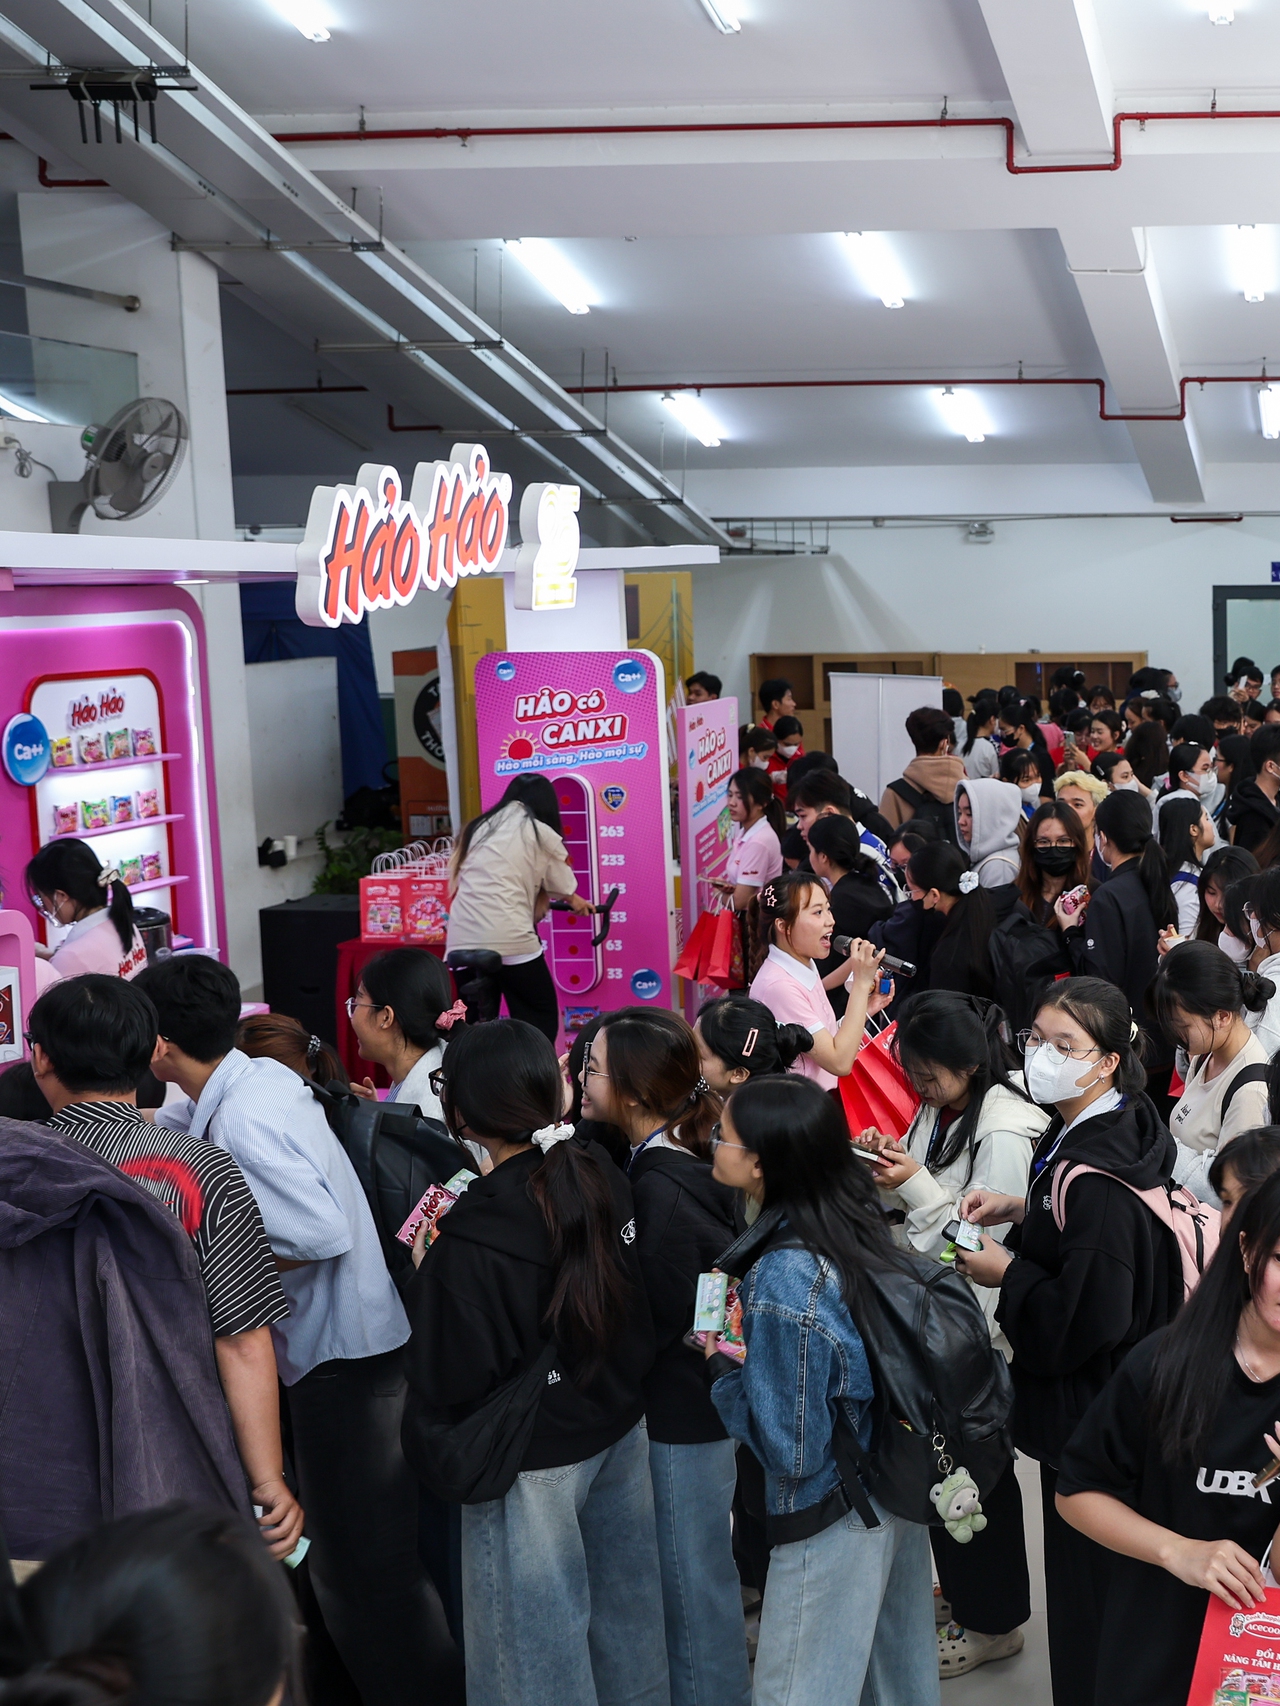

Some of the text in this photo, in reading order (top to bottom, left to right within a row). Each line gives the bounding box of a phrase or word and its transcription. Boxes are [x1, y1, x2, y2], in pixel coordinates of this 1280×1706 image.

[323, 454, 505, 620] Hảo Hảo
[618, 672, 642, 683] Ca++
[72, 688, 125, 727] Hảo Hảo
[516, 689, 601, 718] HẢO có
[543, 716, 622, 745] CANXI
[699, 727, 726, 759] HẢO có
[14, 743, 44, 761] Ca++
[605, 745, 627, 760] mọi
[629, 743, 644, 757] sự
[707, 751, 732, 786] CANXI
[600, 826, 625, 837] 263
[601, 855, 625, 866] 233
[609, 912, 628, 923] 33
[605, 940, 623, 951] 63
[607, 968, 623, 979] 33
[635, 980, 657, 988] Ca++
[420, 1190, 445, 1220] Hảo
[1245, 1612, 1261, 1621] Cook
[1223, 1653, 1249, 1665] NÂNG
[1256, 1648, 1275, 1659] ĐỔI
